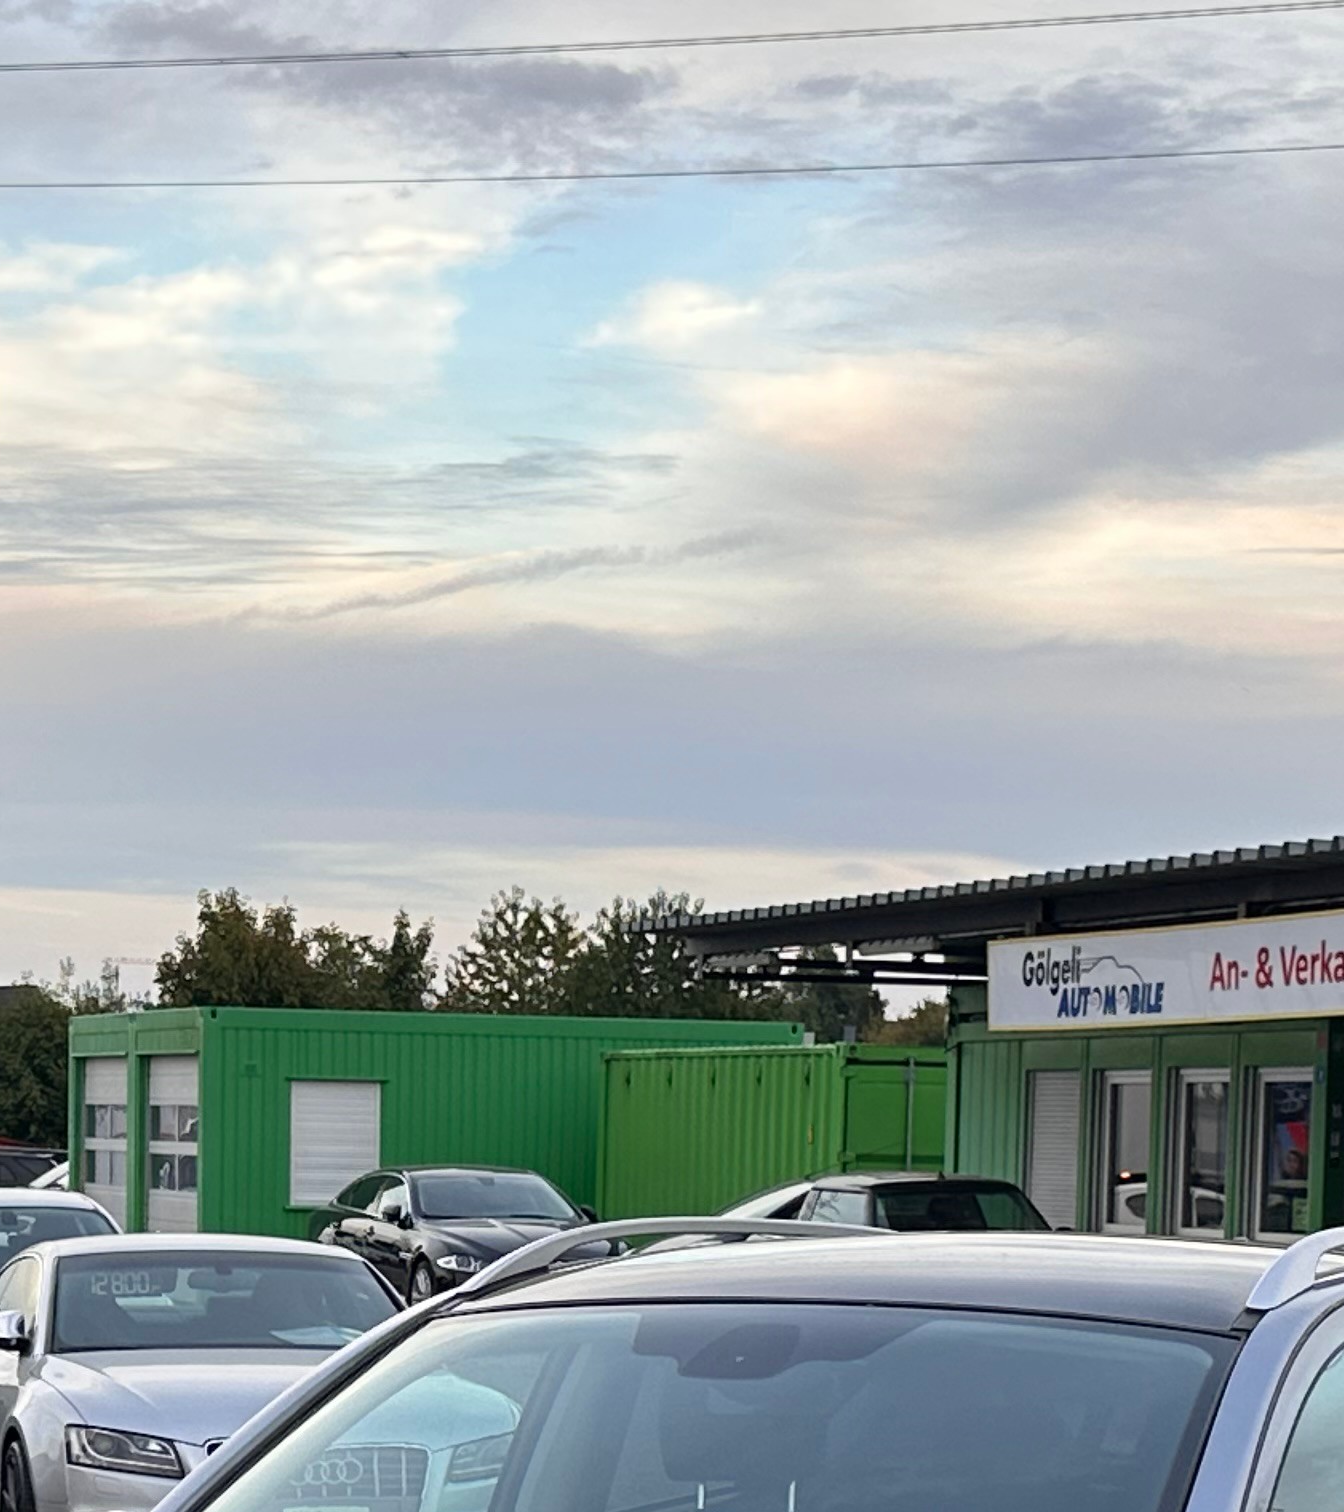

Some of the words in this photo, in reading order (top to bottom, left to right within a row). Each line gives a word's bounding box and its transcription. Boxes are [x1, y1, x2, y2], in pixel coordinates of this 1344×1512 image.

[1022, 946, 1081, 996] Gölgeli
[1209, 952, 1249, 991] An-
[1255, 947, 1274, 989] &
